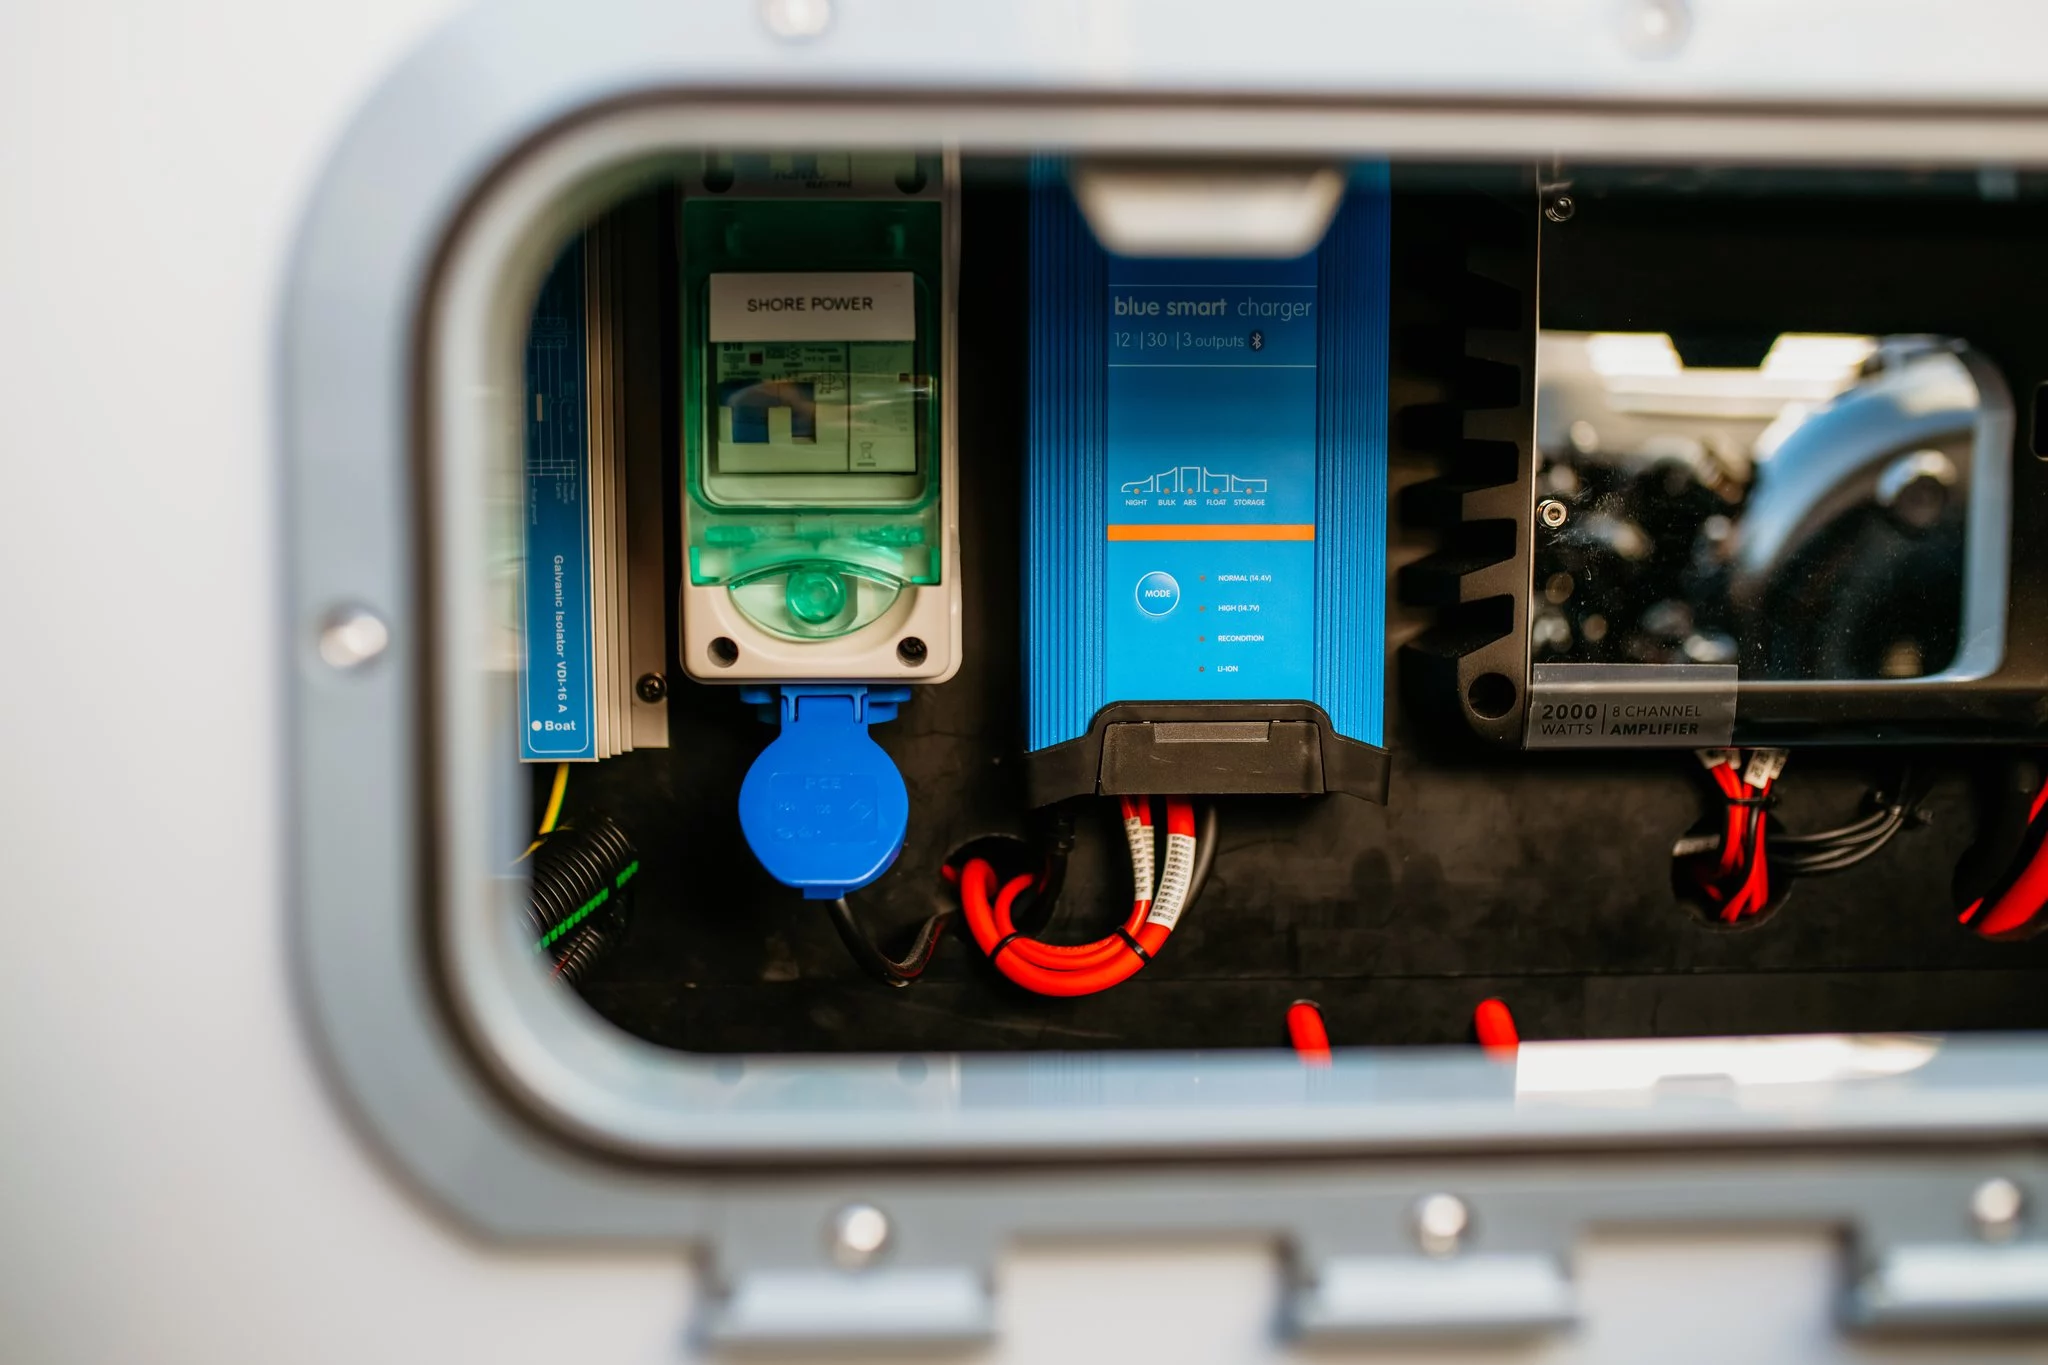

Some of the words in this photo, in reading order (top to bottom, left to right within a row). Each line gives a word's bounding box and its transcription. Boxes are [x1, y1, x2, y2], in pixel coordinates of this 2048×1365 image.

[747, 297, 806, 313] SHORE
[812, 296, 873, 312] POWER
[1114, 296, 1160, 316] blue
[1166, 298, 1227, 316] smart
[1237, 297, 1312, 322] charger
[1114, 332, 1131, 347] 12
[1195, 333, 1245, 350] outputs
[1125, 498, 1147, 506] NIGHT
[1158, 498, 1176, 506] BULK
[1183, 498, 1197, 506] ABS
[1206, 498, 1227, 506] FLOAT
[1233, 498, 1265, 507] STORAGE
[553, 554, 564, 607] Galvanic
[1218, 574, 1248, 582] NORMAL
[1144, 589, 1171, 598] MODE
[1217, 604, 1237, 612] HIGH
[555, 611, 565, 658] Isolator
[1217, 634, 1264, 642] RECONDITION
[556, 661, 567, 701] VDI-16
[558, 704, 568, 713] A
[1541, 703, 1598, 721] 2000
[1612, 705, 1620, 718] 8
[1624, 705, 1702, 718] CHANNEL
[544, 720, 577, 731] Boat
[1541, 723, 1594, 736] WATTS
[1609, 722, 1699, 736] AMPLIFIER
